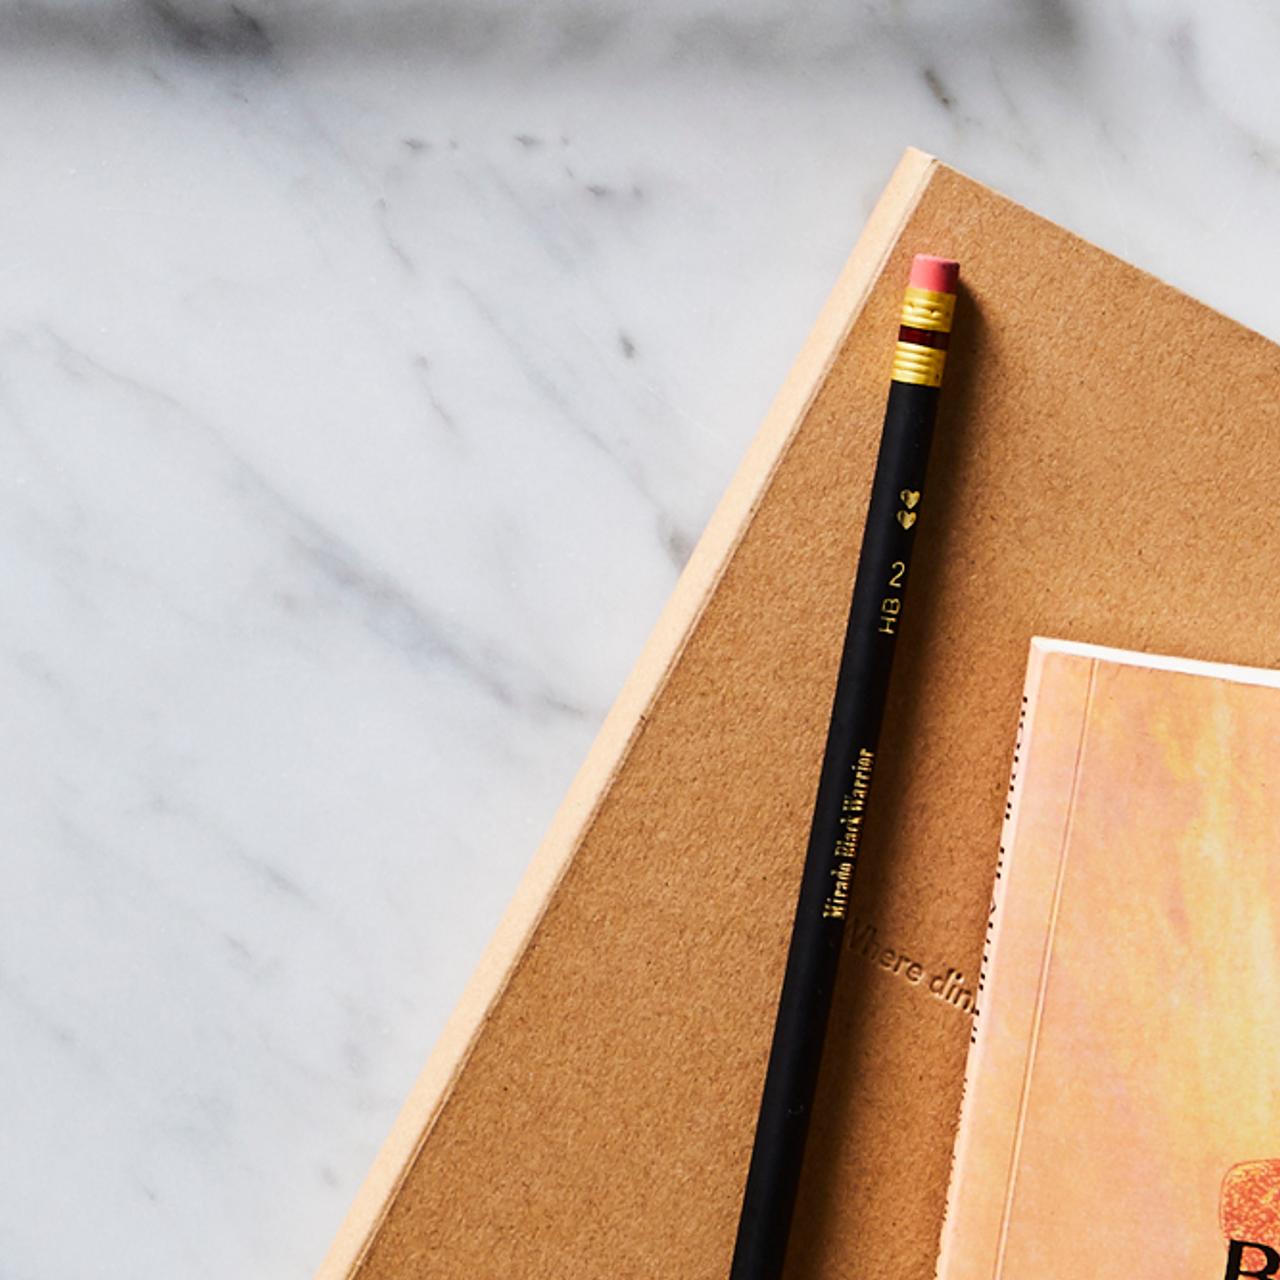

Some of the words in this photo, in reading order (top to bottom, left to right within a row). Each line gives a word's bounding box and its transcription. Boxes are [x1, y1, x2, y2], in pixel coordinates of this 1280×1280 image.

[888, 561, 905, 588] 2
[879, 598, 901, 634] HB
[842, 747, 874, 812] Warrior
[834, 815, 862, 858] Black
[823, 862, 854, 920] Mirado
